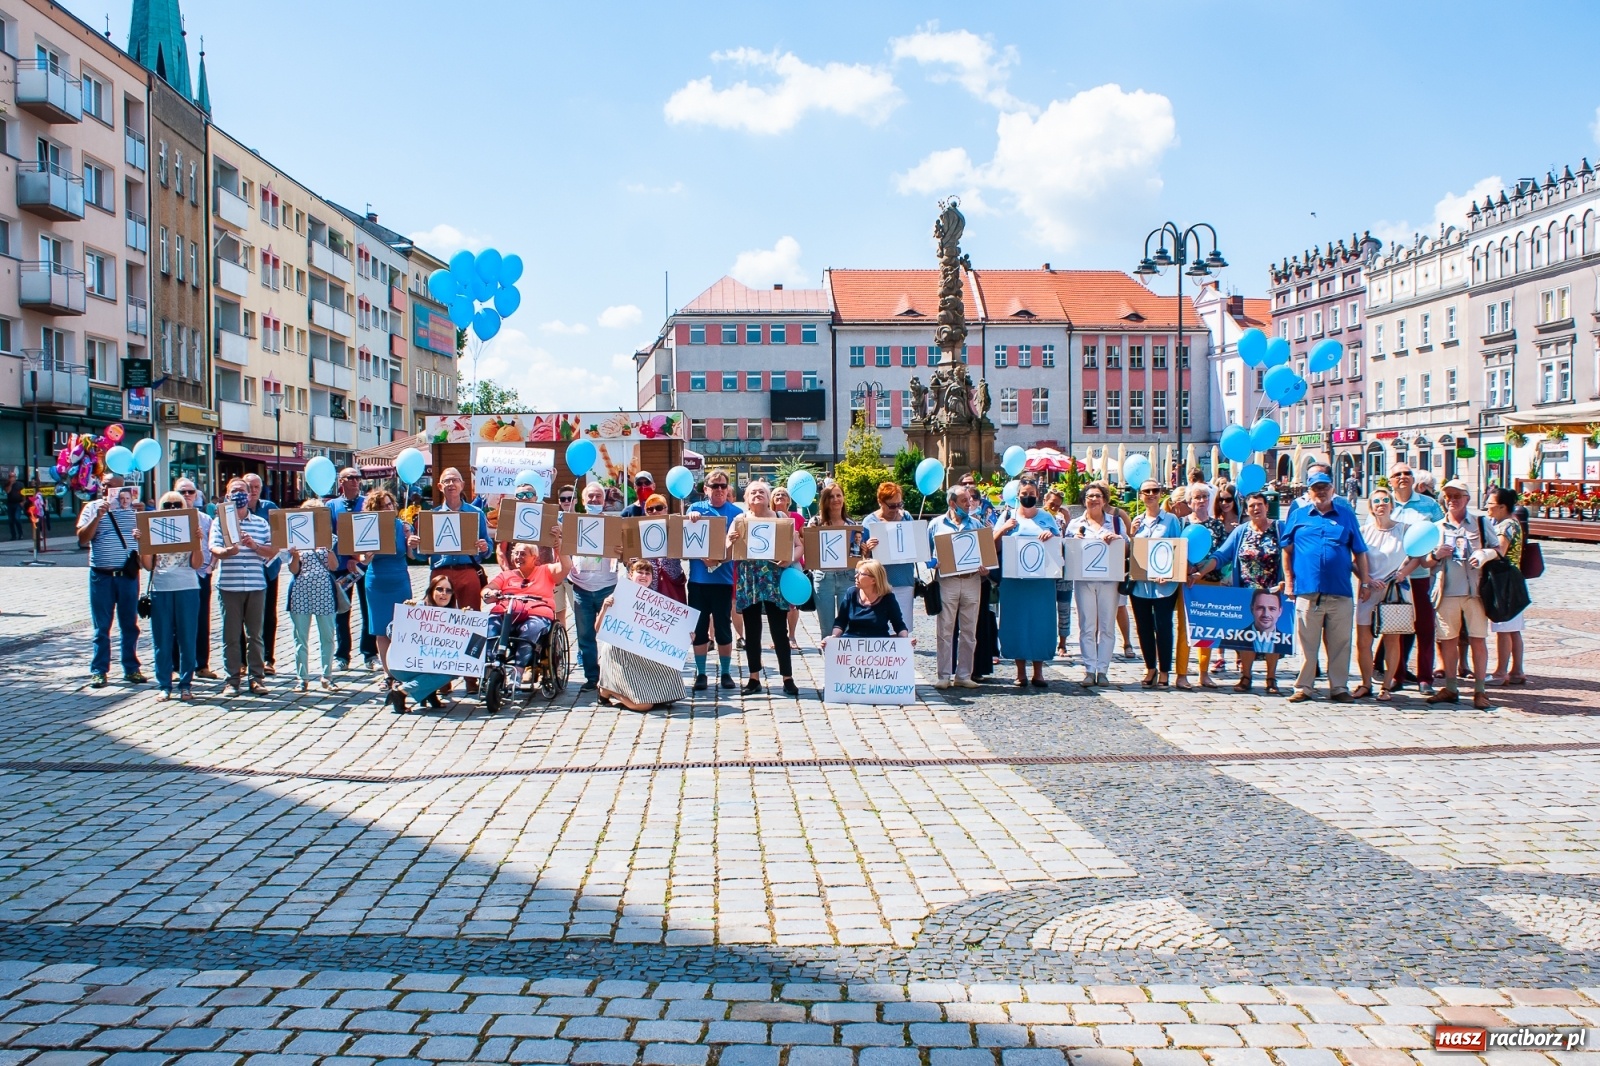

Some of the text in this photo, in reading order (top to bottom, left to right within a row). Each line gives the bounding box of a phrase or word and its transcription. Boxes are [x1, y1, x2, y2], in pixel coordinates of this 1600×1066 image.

[481, 466, 489, 474] O
[287, 514, 310, 544] R
[353, 513, 379, 547] Z
[435, 516, 460, 547] A
[516, 507, 540, 540] S
[578, 519, 600, 549] K
[643, 523, 666, 552] O
[683, 524, 707, 549] W
[750, 524, 770, 553] S
[822, 532, 843, 562] K
[952, 532, 980, 565] 2
[1083, 542, 1107, 572] 2
[635, 586, 689, 619] LEKARSTWEM
[1190, 601, 1242, 612] Silny Prezydent
[632, 600, 680, 627] NA NASZE
[1189, 608, 1243, 619] Wspólna Polska
[397, 632, 407, 643] W
[1188, 625, 1292, 645] TRZASKOWSK
[837, 639, 852, 652] NA
[855, 655, 908, 667] GŁOSUJEMY
[834, 682, 867, 694] DOBRZE
